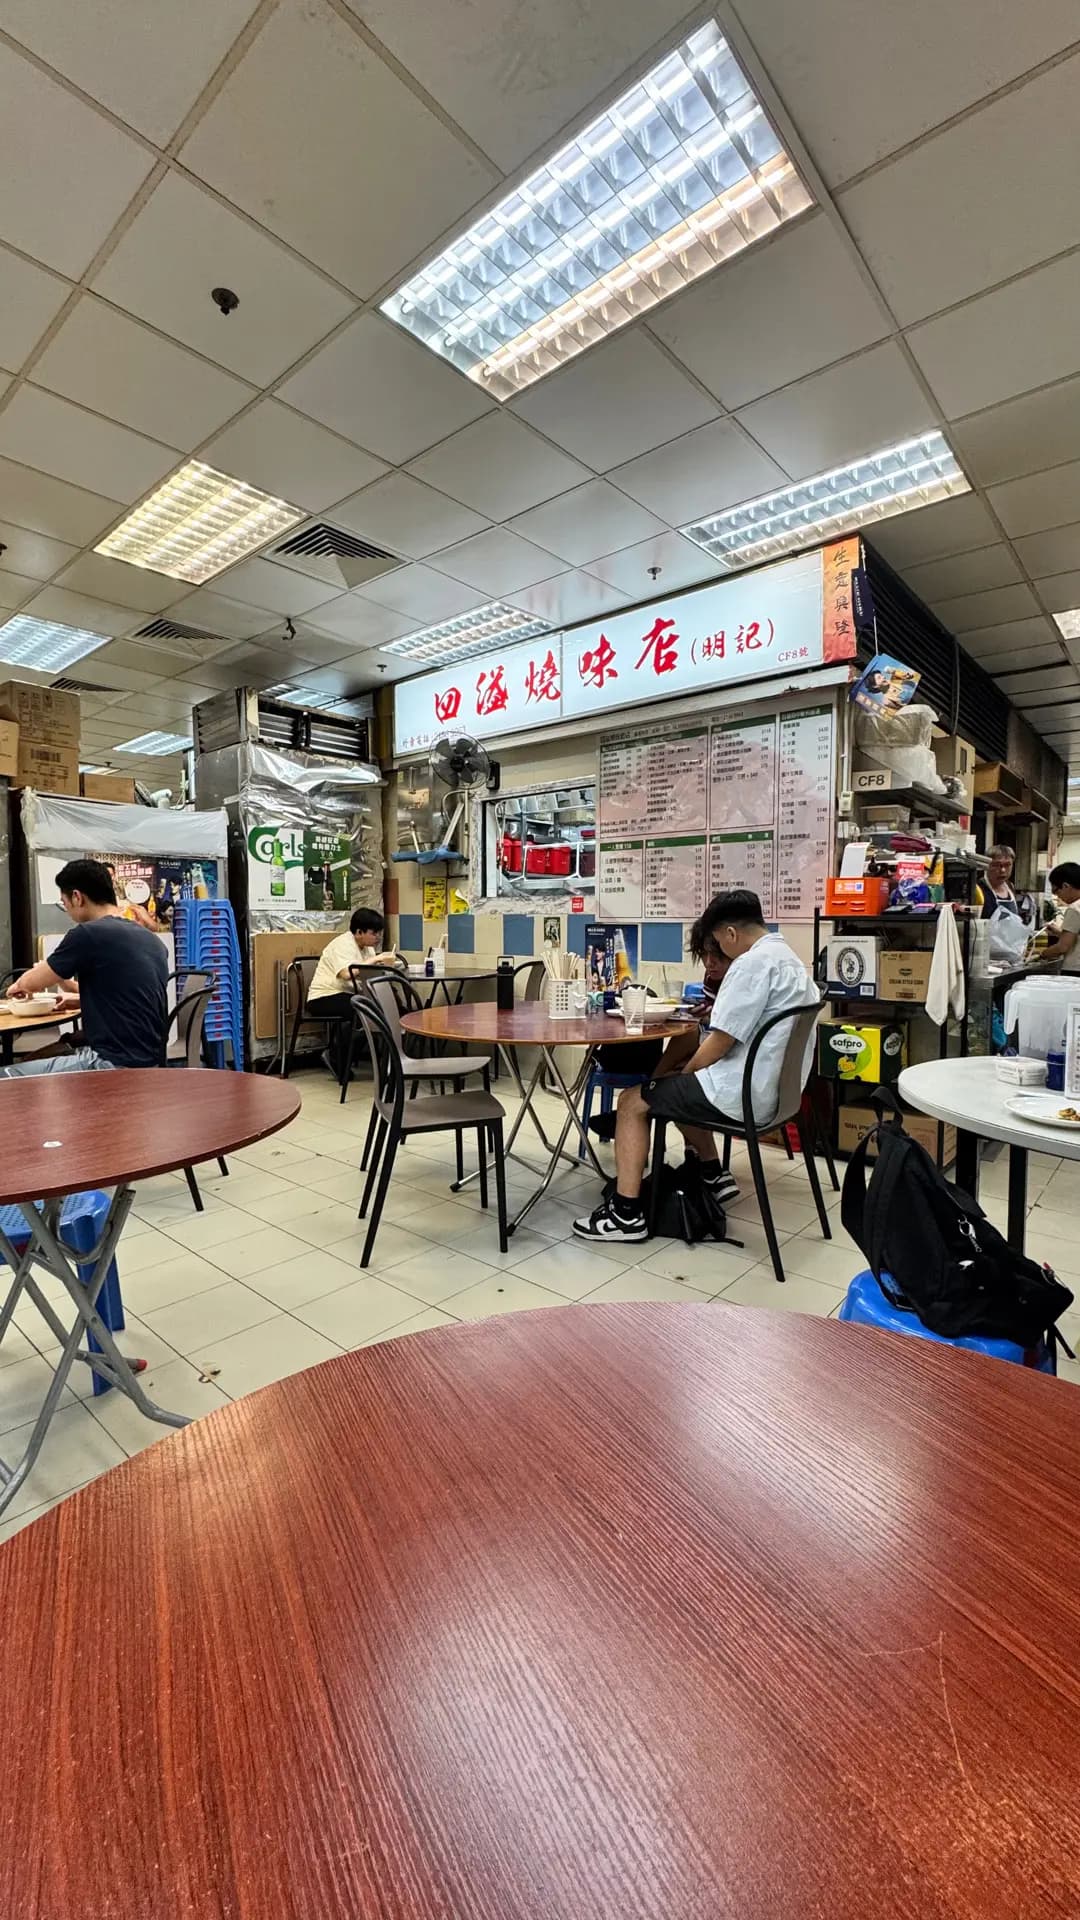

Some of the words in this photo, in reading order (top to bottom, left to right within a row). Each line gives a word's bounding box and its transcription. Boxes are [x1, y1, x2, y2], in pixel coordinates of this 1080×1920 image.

[777, 646, 810, 664] CF8號
[857, 774, 885, 787] CF8
[832, 1037, 862, 1049] safpro
